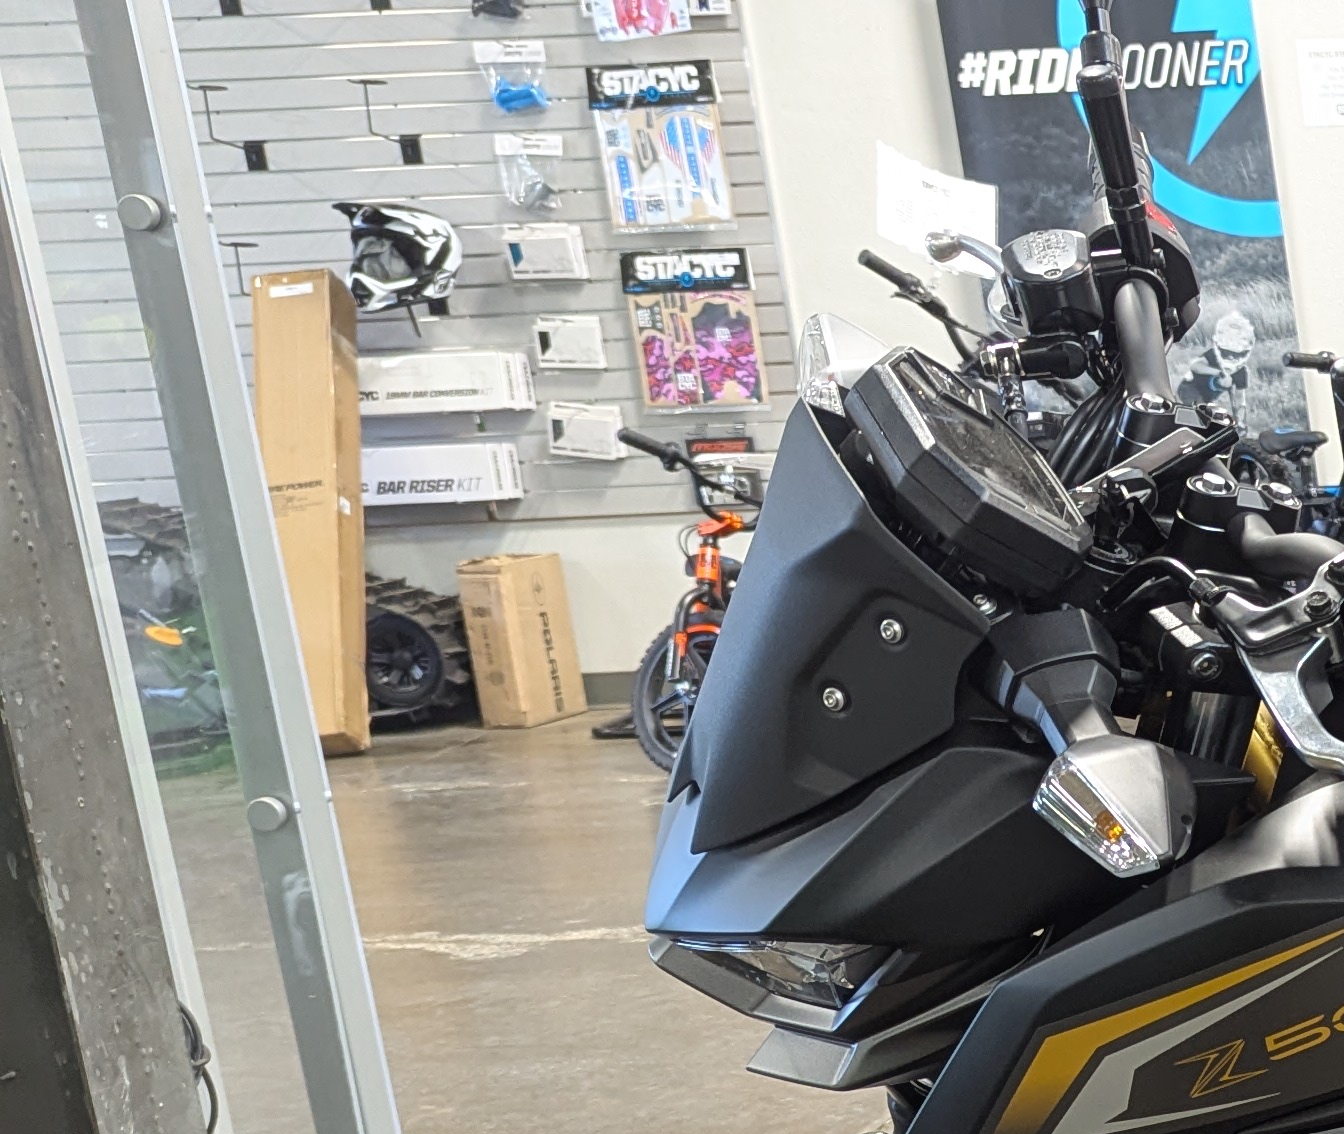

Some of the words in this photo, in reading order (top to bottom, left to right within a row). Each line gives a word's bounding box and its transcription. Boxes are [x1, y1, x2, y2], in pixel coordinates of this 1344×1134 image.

[602, 65, 701, 97] STACYC
[634, 253, 741, 281] STACYC
[376, 480, 407, 496] BAR
[409, 479, 455, 494] RISER
[458, 477, 484, 492] KIT
